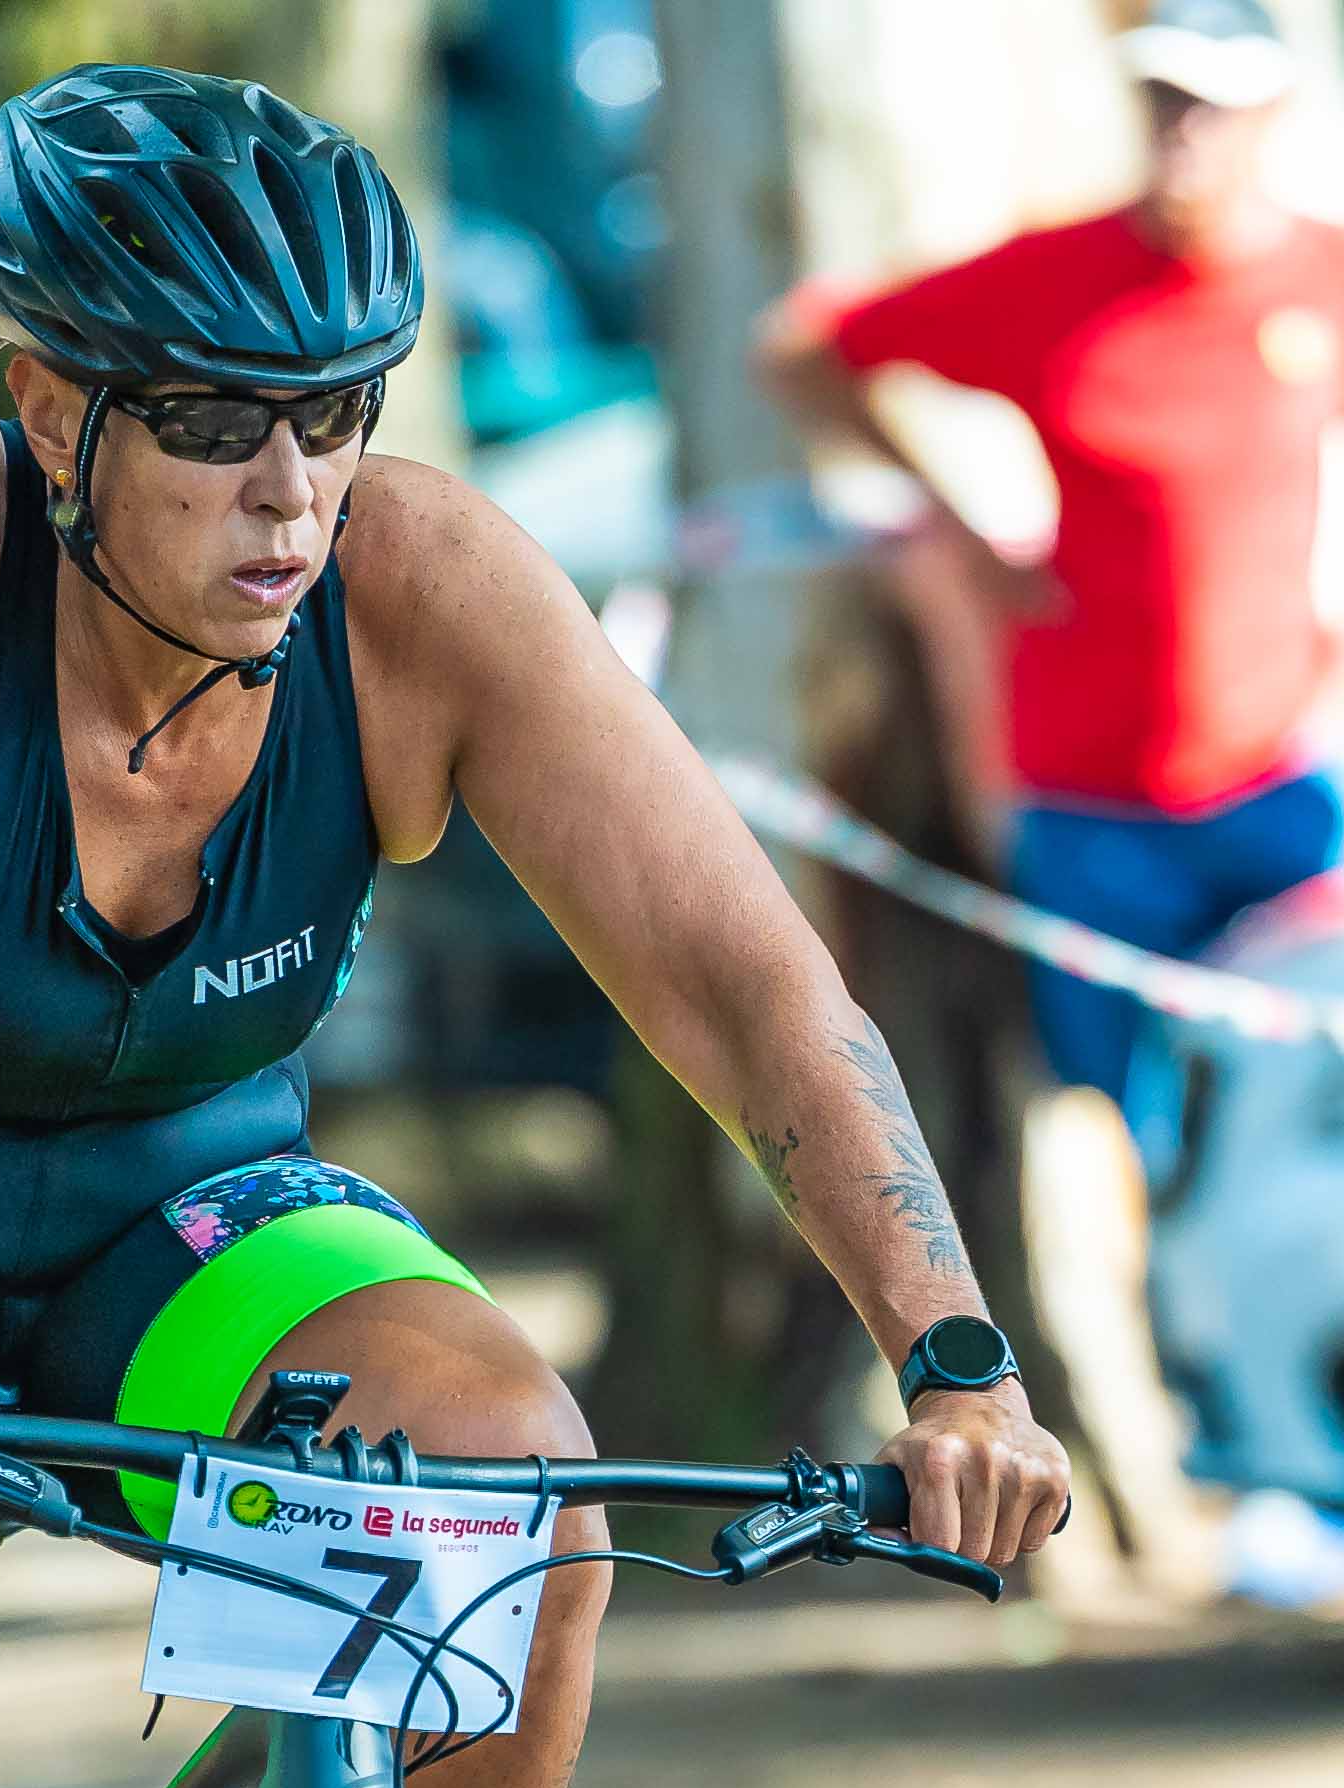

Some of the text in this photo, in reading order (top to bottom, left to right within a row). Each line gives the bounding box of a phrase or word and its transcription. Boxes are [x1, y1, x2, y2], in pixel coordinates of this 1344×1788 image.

[287, 1371, 340, 1386] CATEYE
[402, 1510, 520, 1539] la segunda
[312, 1547, 423, 1699] 7
